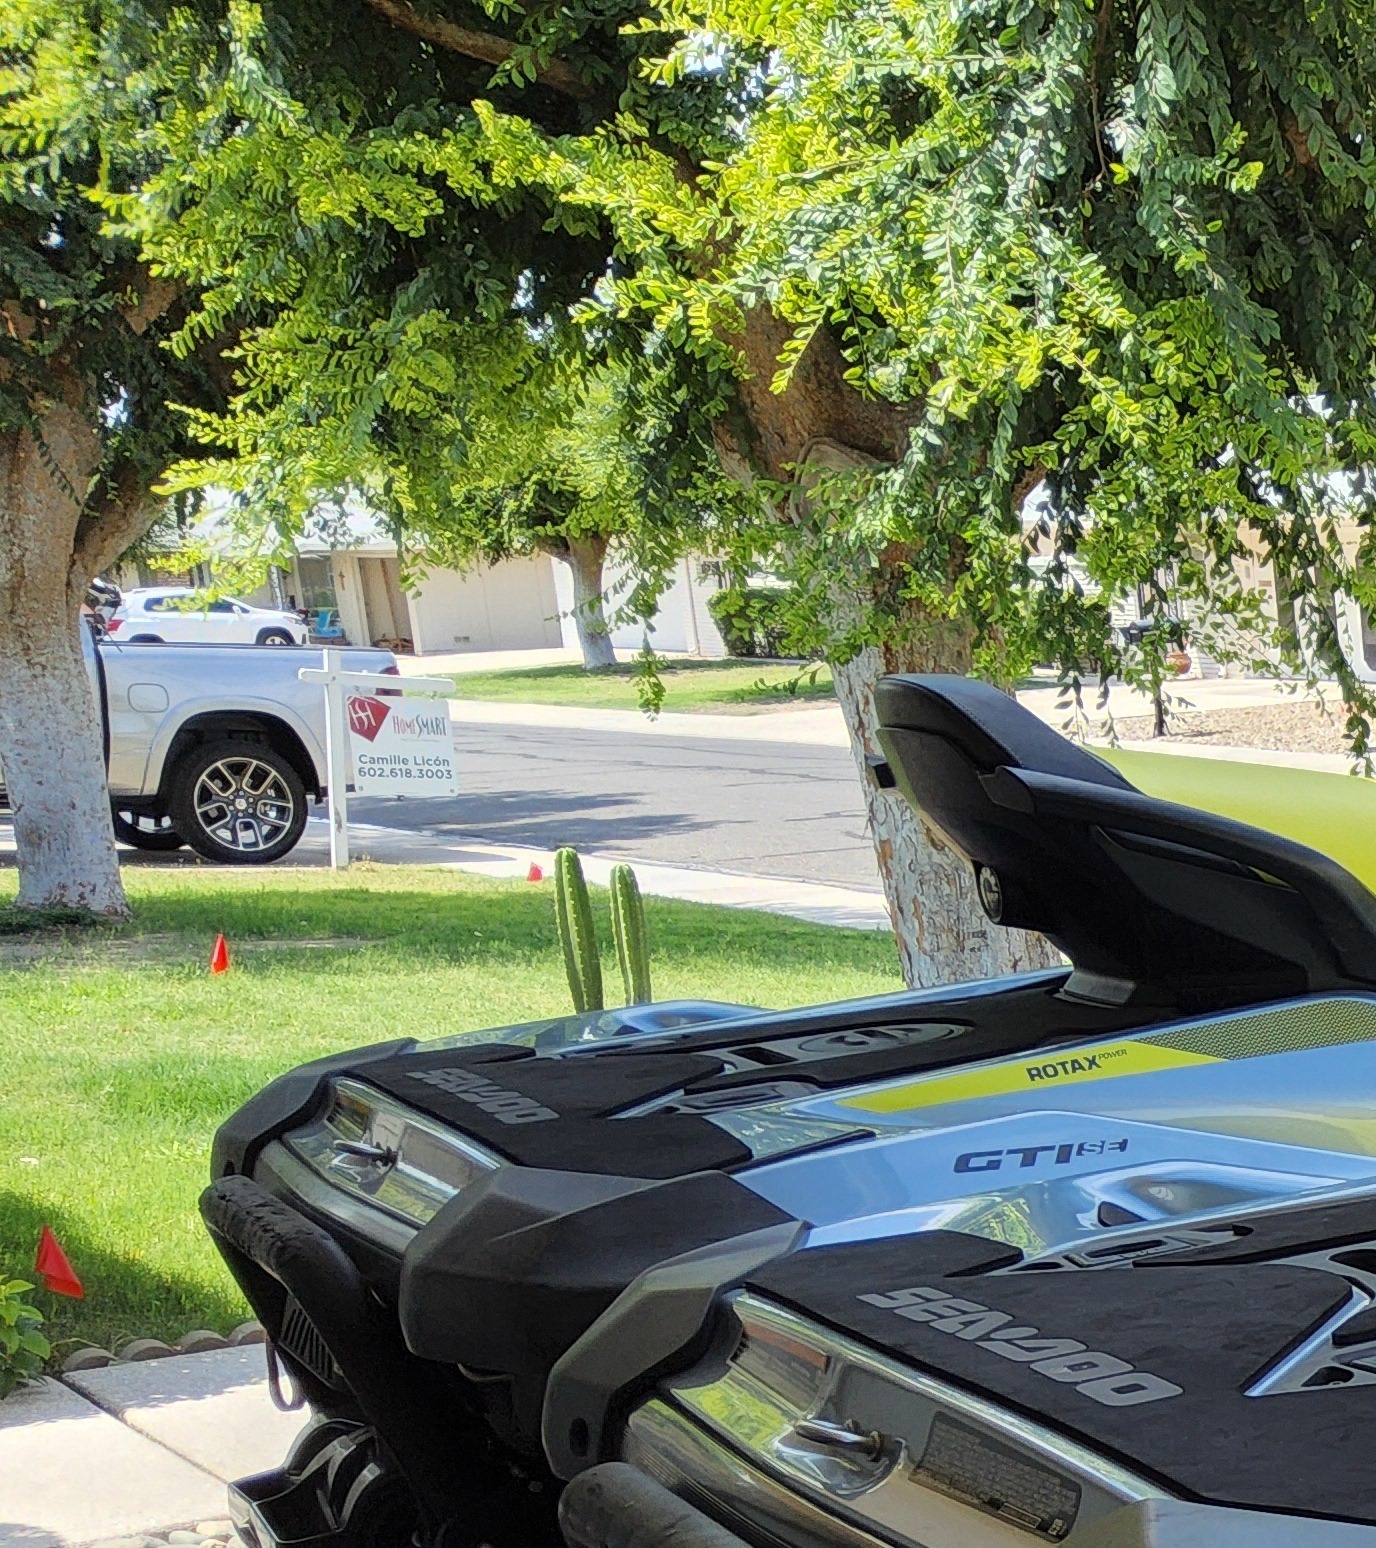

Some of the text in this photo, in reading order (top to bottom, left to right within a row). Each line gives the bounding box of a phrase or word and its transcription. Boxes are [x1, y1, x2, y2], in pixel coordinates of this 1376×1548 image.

[359, 754, 409, 766] Camille
[358, 768, 452, 779] 602.618.3003
[1025, 1048, 1128, 1082] ROTAX POWER
